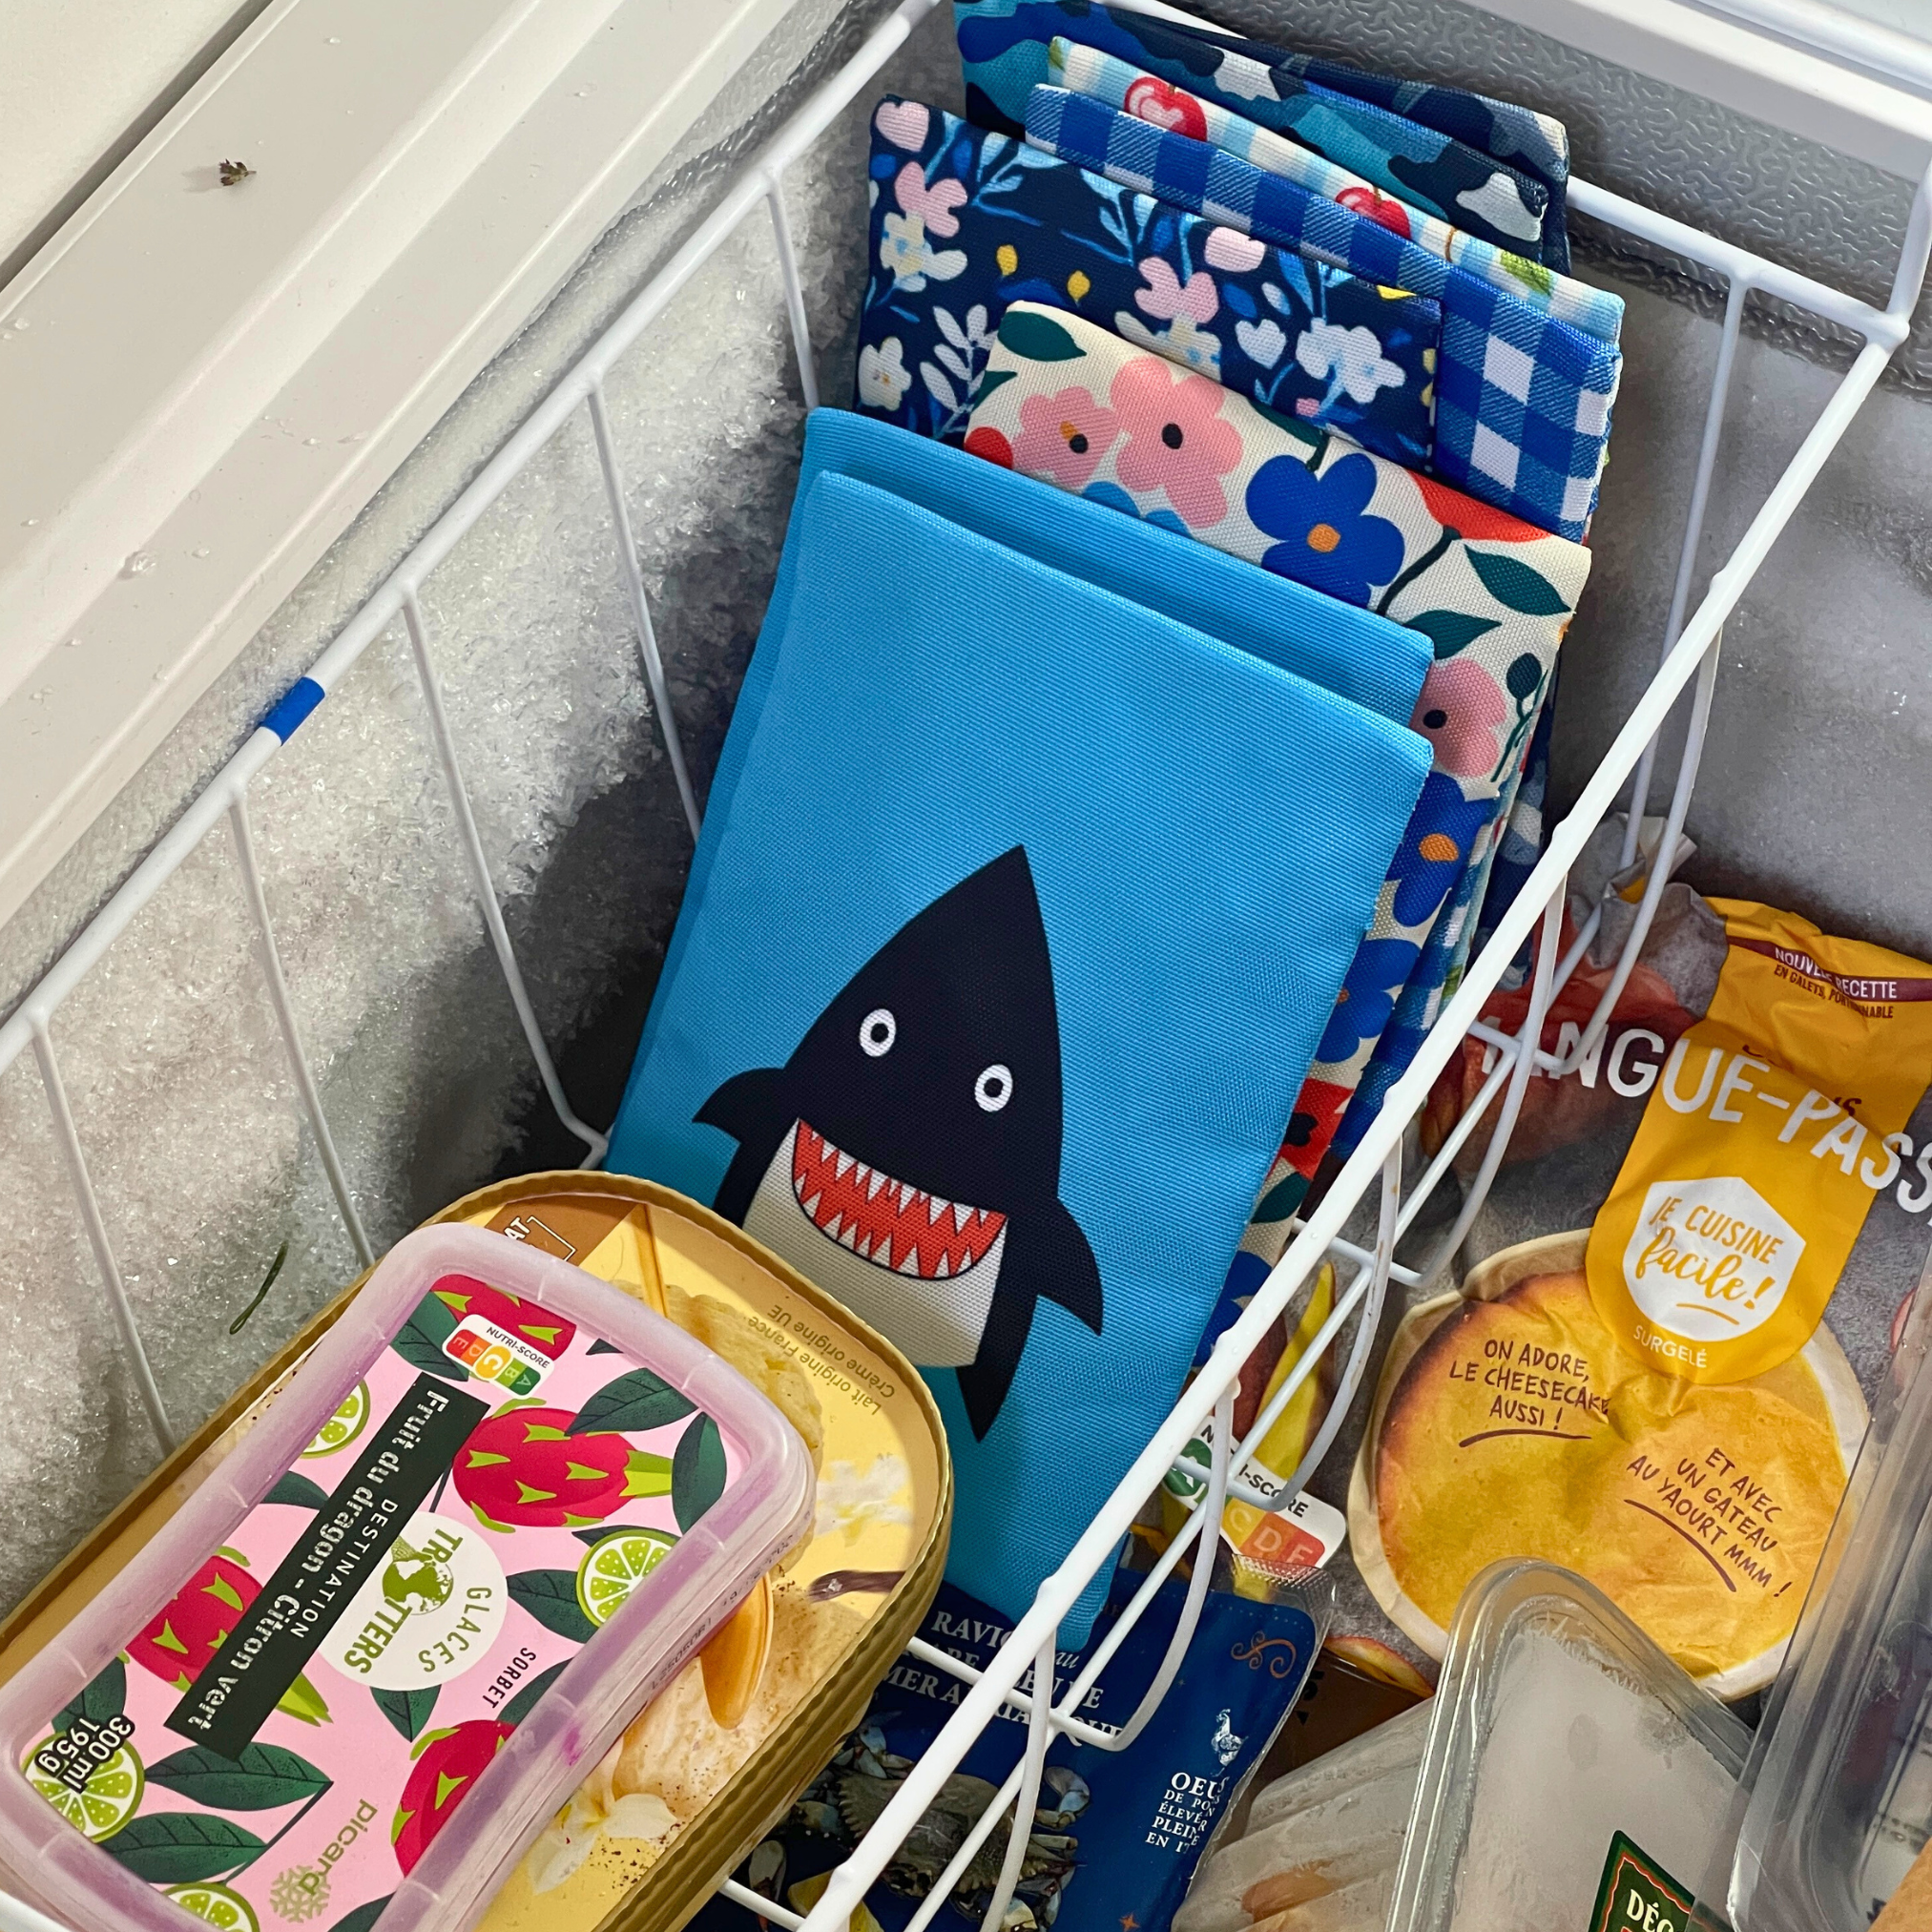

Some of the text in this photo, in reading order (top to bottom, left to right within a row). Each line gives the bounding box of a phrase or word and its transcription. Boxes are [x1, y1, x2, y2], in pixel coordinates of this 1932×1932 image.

[1774, 964, 1789, 979] EN
[1835, 976, 1898, 999] RECETTE
[1648, 1195, 1784, 1264] JE CUISINE
[483, 1353, 504, 1371] C
[486, 1325, 551, 1369] NUTRI-SCORE
[504, 1366, 520, 1379] B
[748, 1316, 883, 1416] Lait origine France
[767, 1304, 896, 1399] Crème origine UE
[1484, 1339, 1589, 1382] ON ADORE,
[1632, 1324, 1707, 1368] SURGELÉ
[1449, 1360, 1610, 1416] LE CHEESECAKE
[1489, 1394, 1545, 1426] AUSSI
[392, 1390, 450, 1450] Fruit
[366, 1450, 401, 1485] du
[1705, 1447, 1783, 1523] ET AVEC
[301, 1485, 375, 1573] dragon
[1626, 1455, 1660, 1481] AU
[1656, 1477, 1728, 1546] YAOURT
[1723, 1544, 1773, 1588] MMM
[1677, 1458, 1778, 1552] UN GATEAU
[290, 1498, 399, 1638] DESTINATION
[1254, 1526, 1282, 1552] D
[230, 1594, 301, 1671] Citron
[417, 1587, 493, 1672] GLACES
[187, 1676, 239, 1731] vert
[482, 1647, 537, 1709] SORBET
[63, 1716, 132, 1789] 300 ml
[1164, 1789, 1184, 1803] DE
[299, 1798, 378, 1896] picard
[1146, 1831, 1170, 1848] EN
